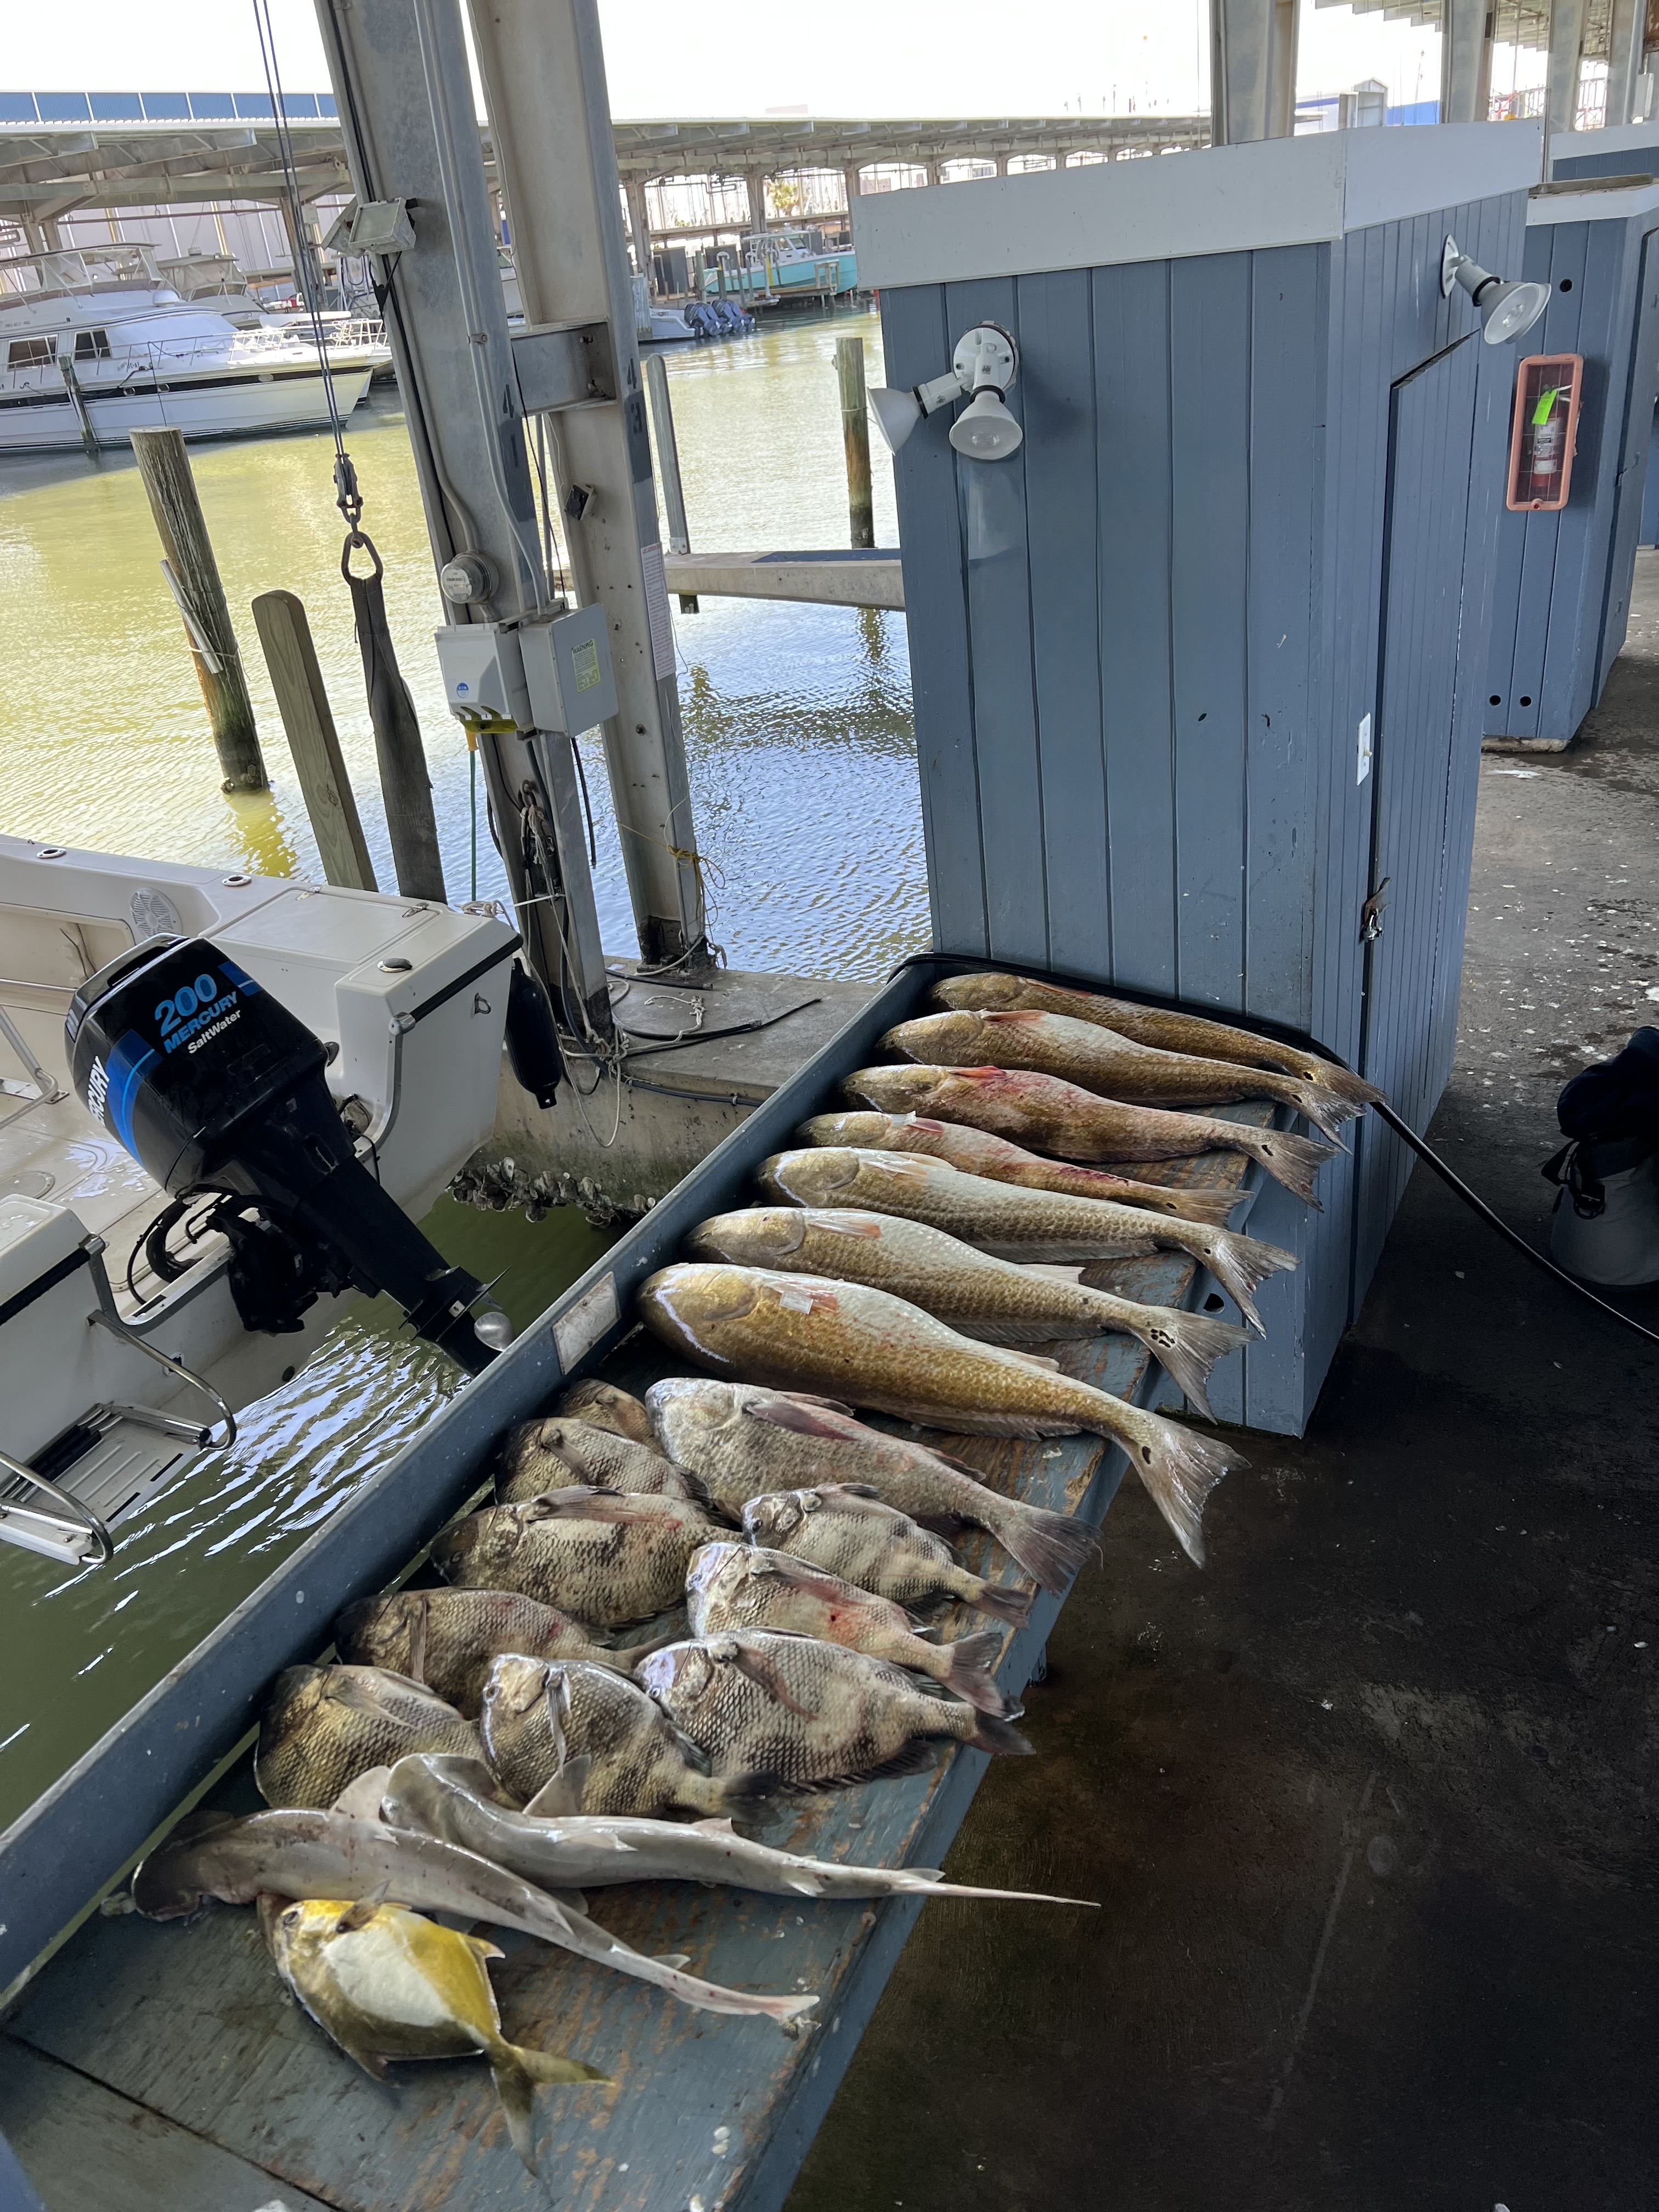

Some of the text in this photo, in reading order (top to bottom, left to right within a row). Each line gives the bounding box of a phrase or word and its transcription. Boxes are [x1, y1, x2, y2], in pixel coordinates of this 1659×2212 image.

[155, 974, 217, 1037] 200
[164, 991, 237, 1053] MERCURY
[188, 1010, 240, 1053] SaltWater
